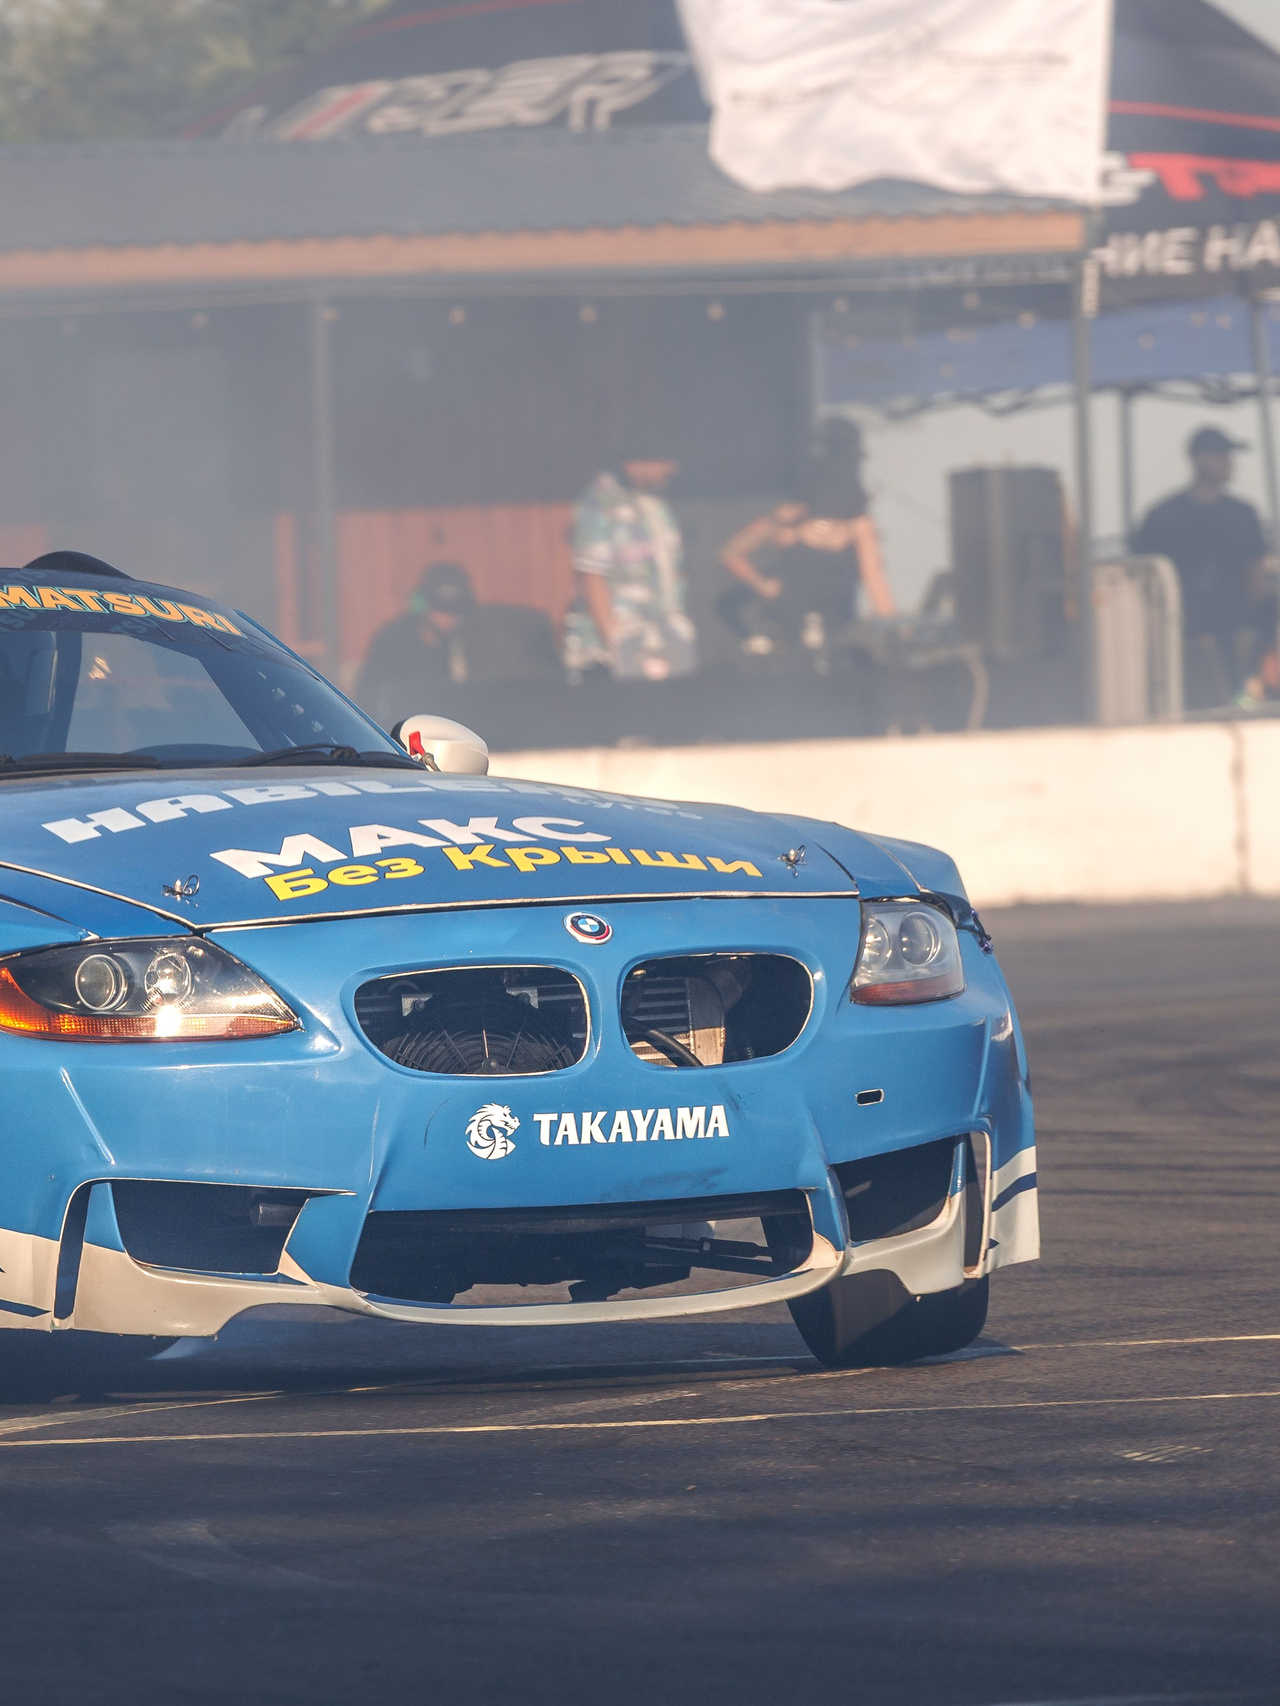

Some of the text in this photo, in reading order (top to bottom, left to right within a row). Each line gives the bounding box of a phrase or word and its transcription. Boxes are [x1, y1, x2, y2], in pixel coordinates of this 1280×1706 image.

[209, 816, 613, 879] МАКС
[263, 844, 763, 901] Без Крыши
[533, 1105, 730, 1146] TAKAYAMA
